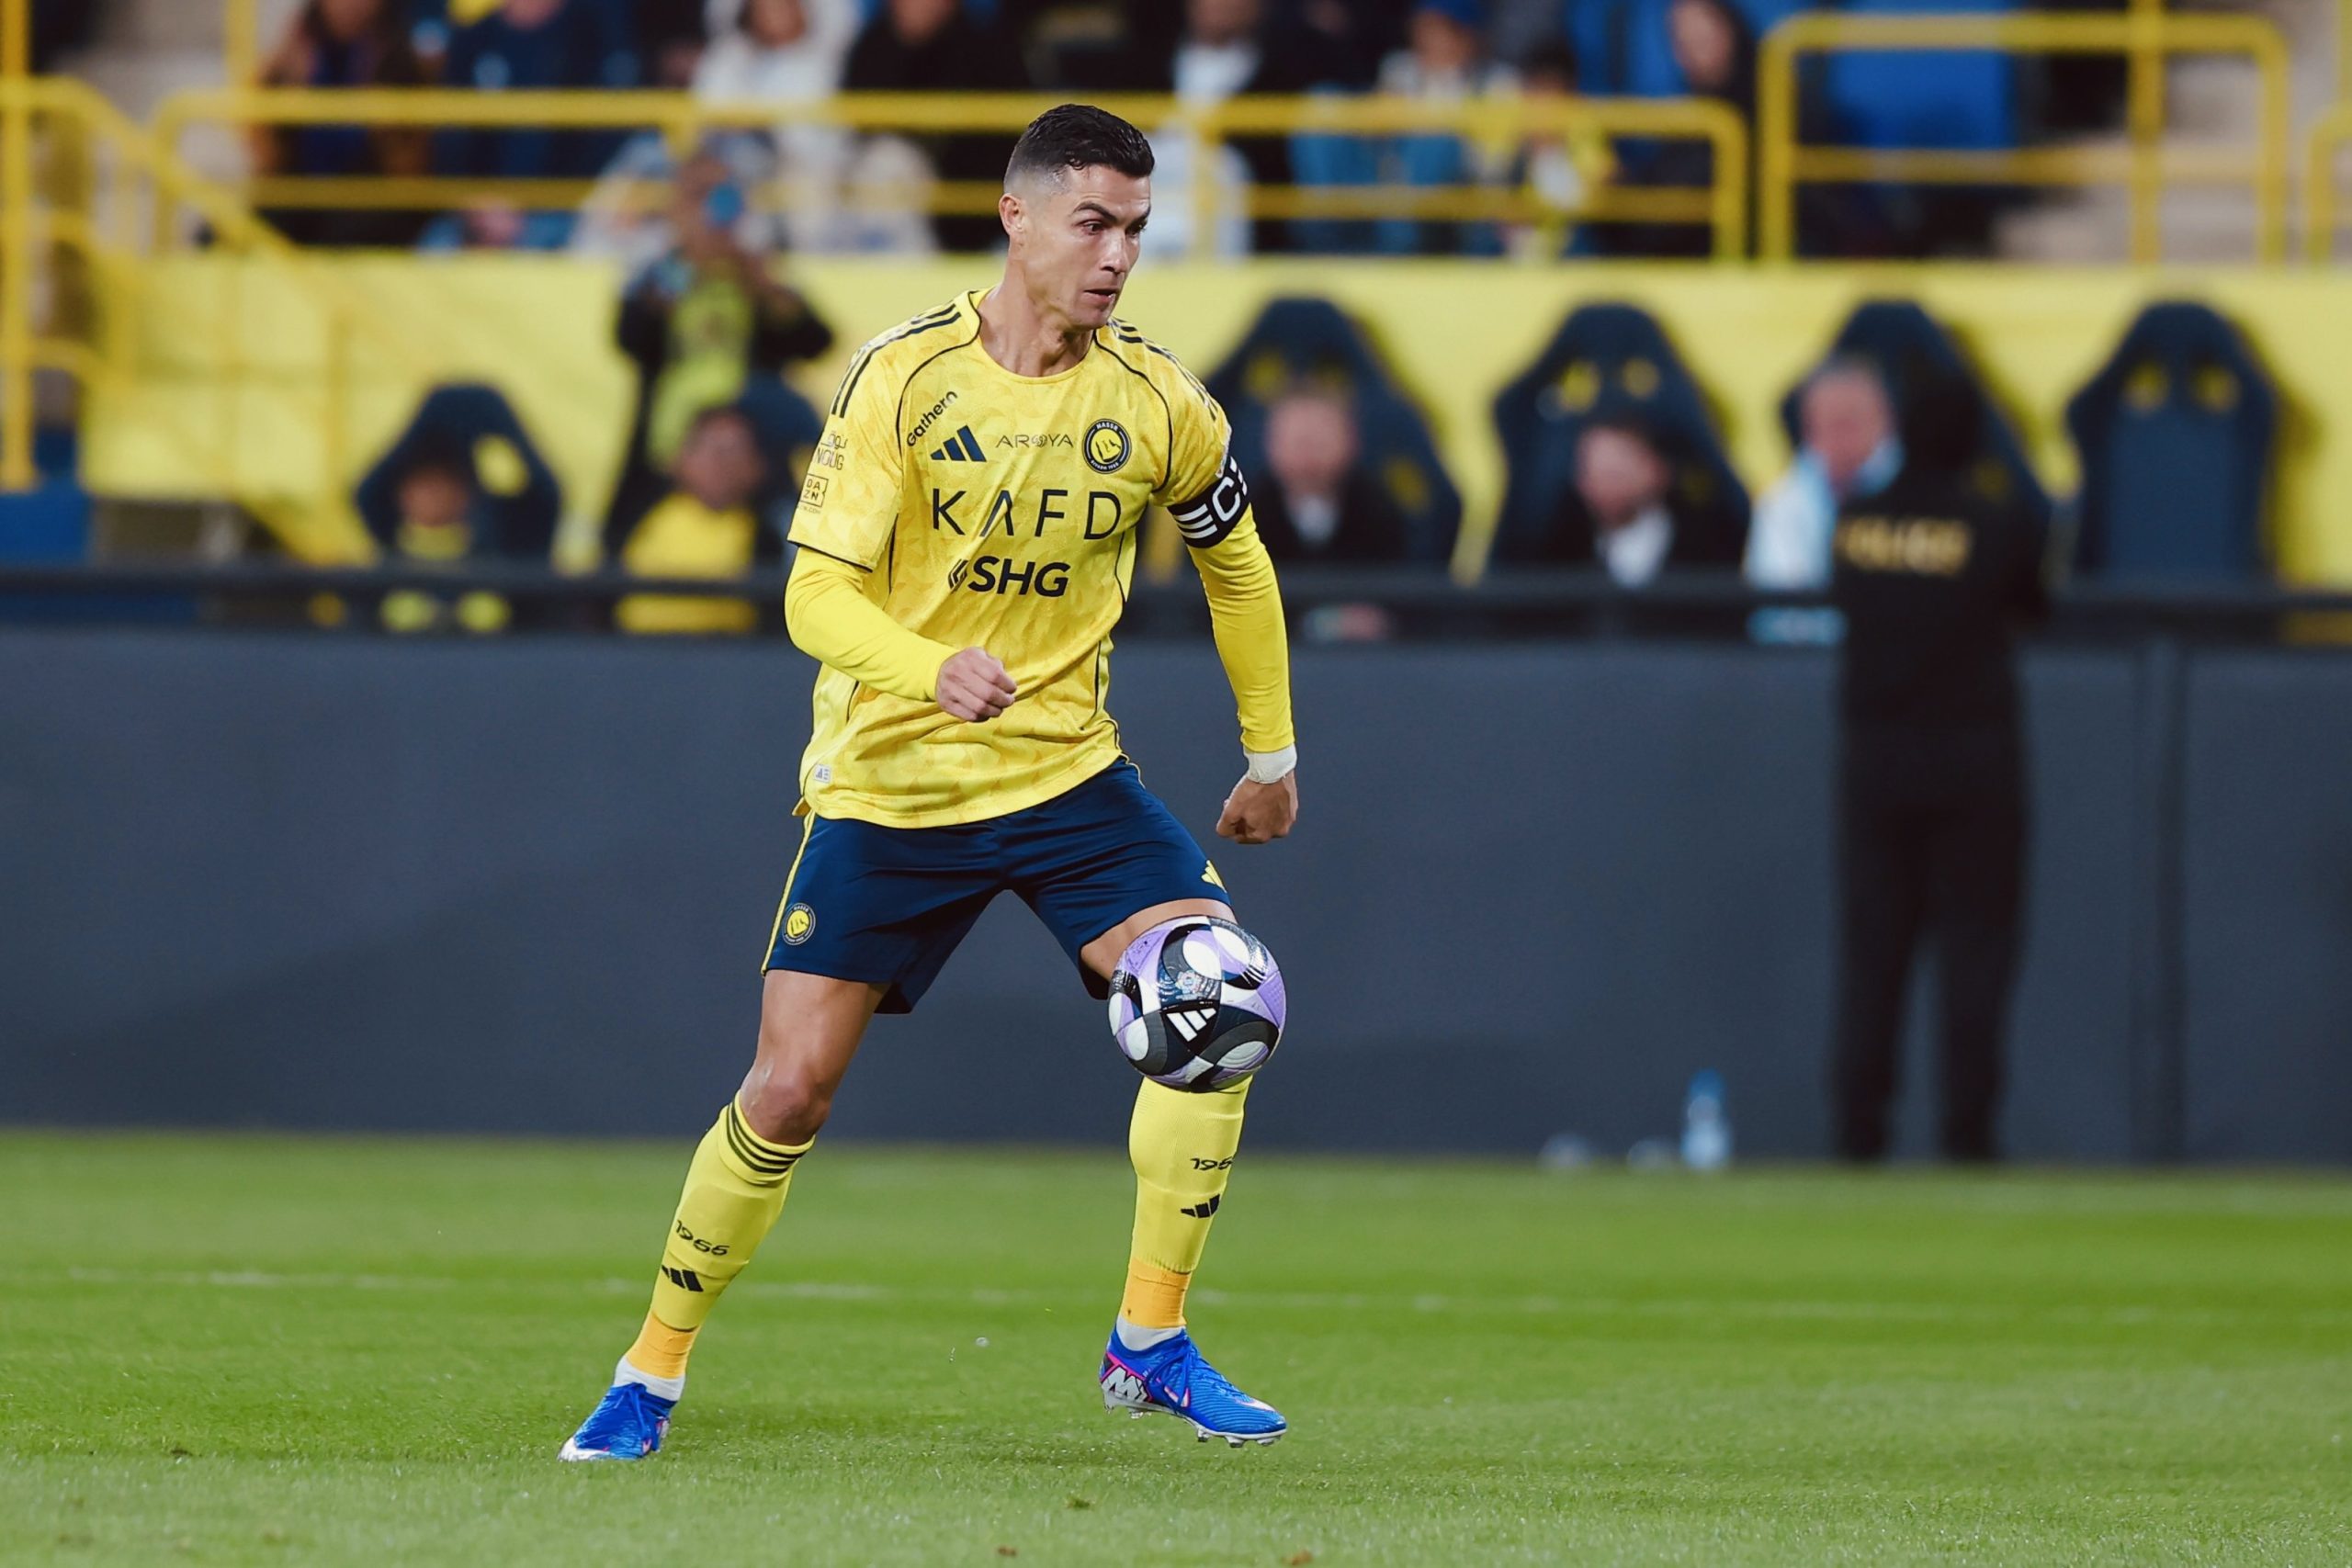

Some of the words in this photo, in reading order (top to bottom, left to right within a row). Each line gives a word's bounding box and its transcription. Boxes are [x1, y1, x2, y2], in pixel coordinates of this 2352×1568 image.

[907, 390, 957, 447] Gathern
[817, 447, 844, 470] NOUG
[996, 434, 1074, 448] AROYA
[933, 488, 1122, 540] KAFD
[967, 555, 1071, 597] SHG
